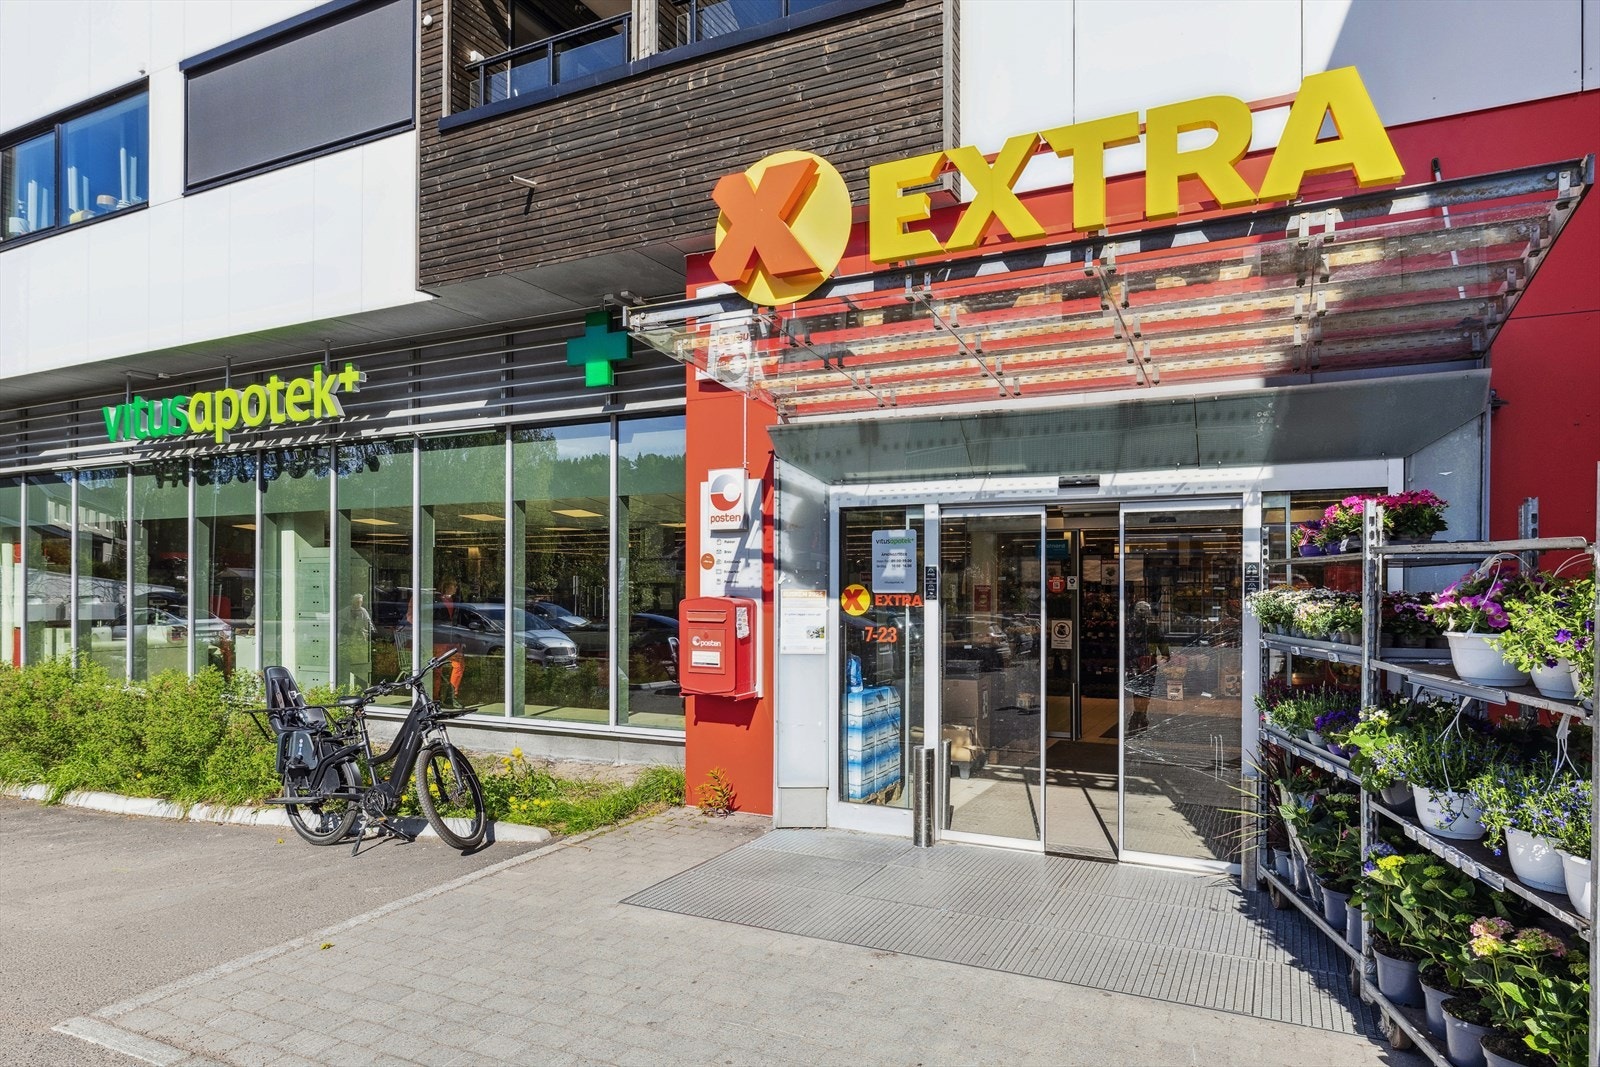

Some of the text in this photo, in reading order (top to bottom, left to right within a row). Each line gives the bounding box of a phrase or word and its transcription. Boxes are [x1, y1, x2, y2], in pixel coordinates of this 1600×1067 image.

[869, 65, 1406, 265] EXTRA
[710, 513, 741, 524] posten
[875, 594, 923, 606] EXTRA
[865, 626, 898, 643] 7-23
